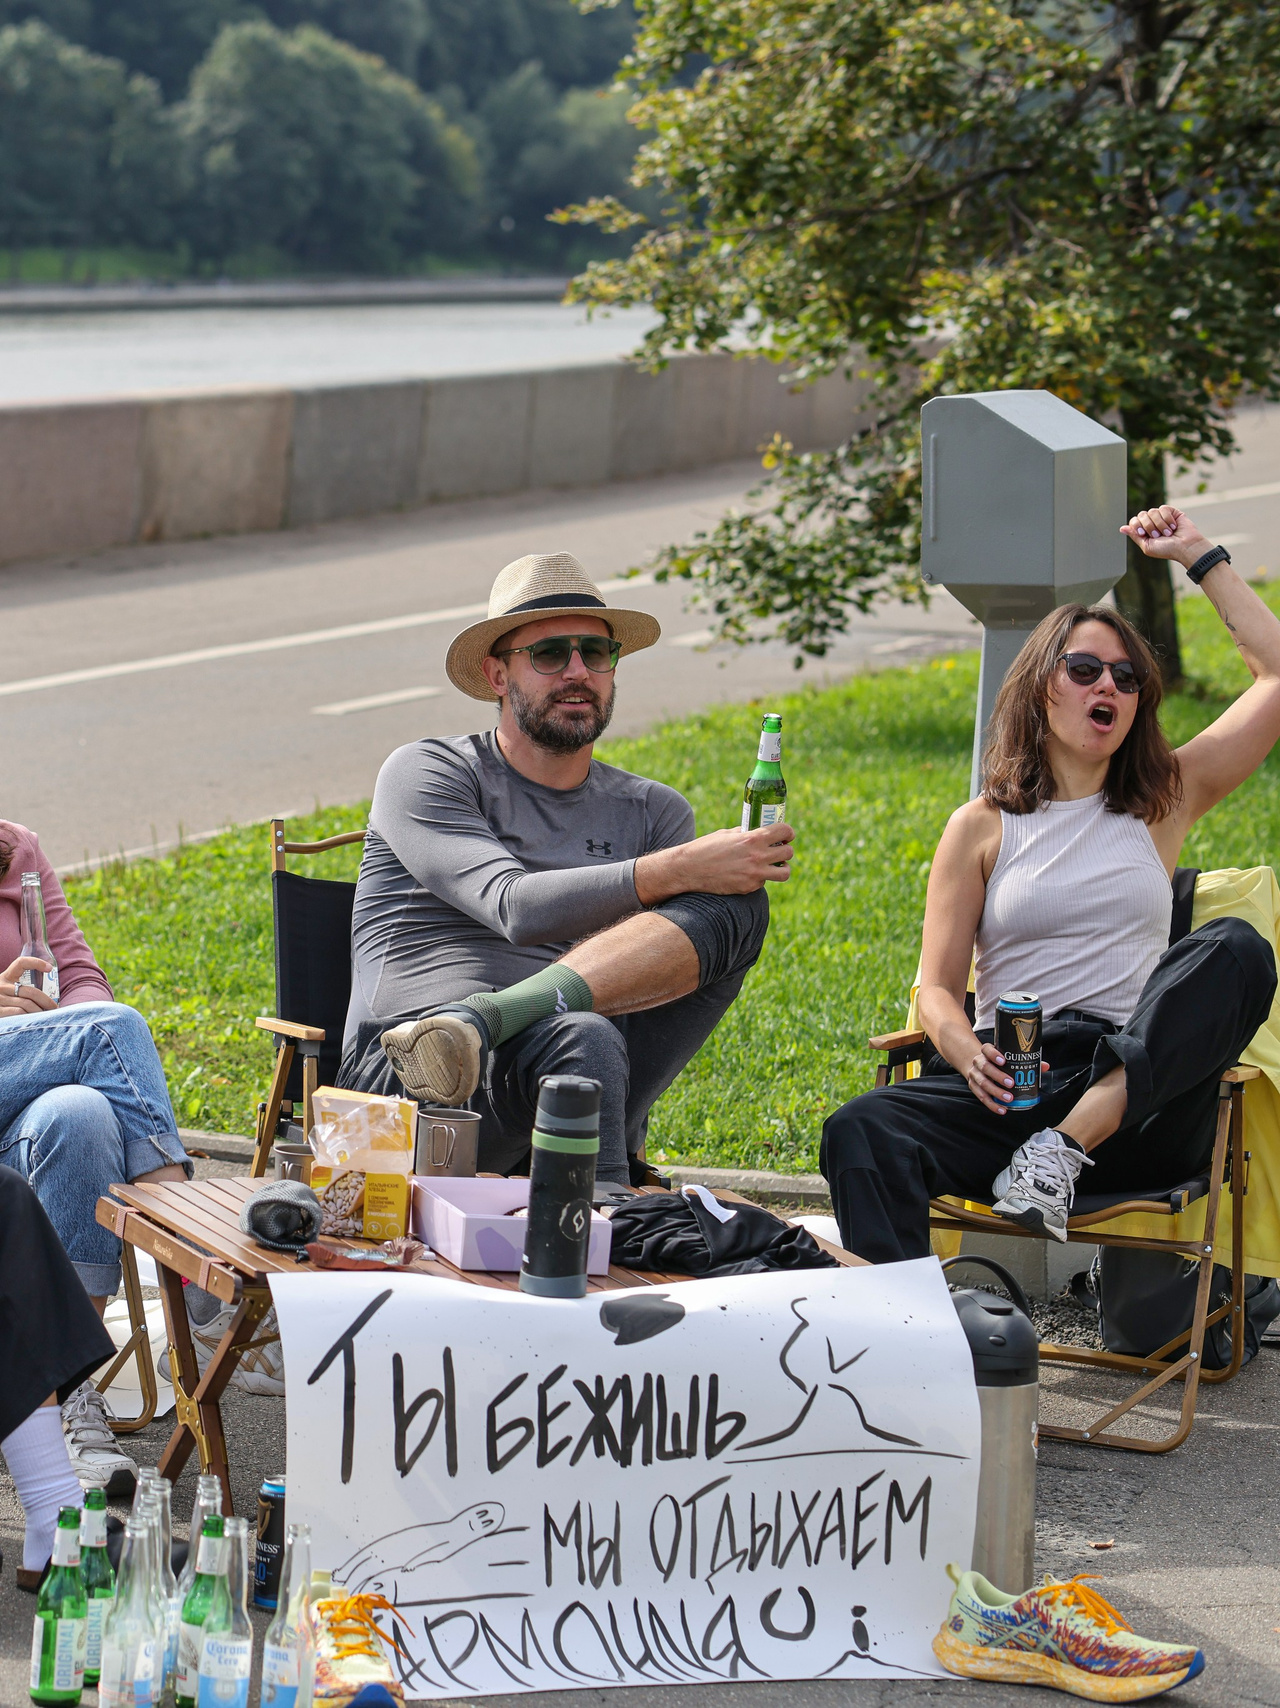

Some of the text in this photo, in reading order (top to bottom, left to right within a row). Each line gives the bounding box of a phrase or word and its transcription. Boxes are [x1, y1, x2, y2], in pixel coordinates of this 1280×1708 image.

[1015, 1069, 1036, 1086] 0.0
[306, 1289, 747, 1484] ТЫ БЕЖИШЬ
[543, 1469, 932, 1596] МЫ ОТДЫХАЕМ
[56, 1623, 75, 1688] ORIGINAL
[86, 1602, 103, 1667] ORIGINAL
[206, 1641, 248, 1657] Corona
